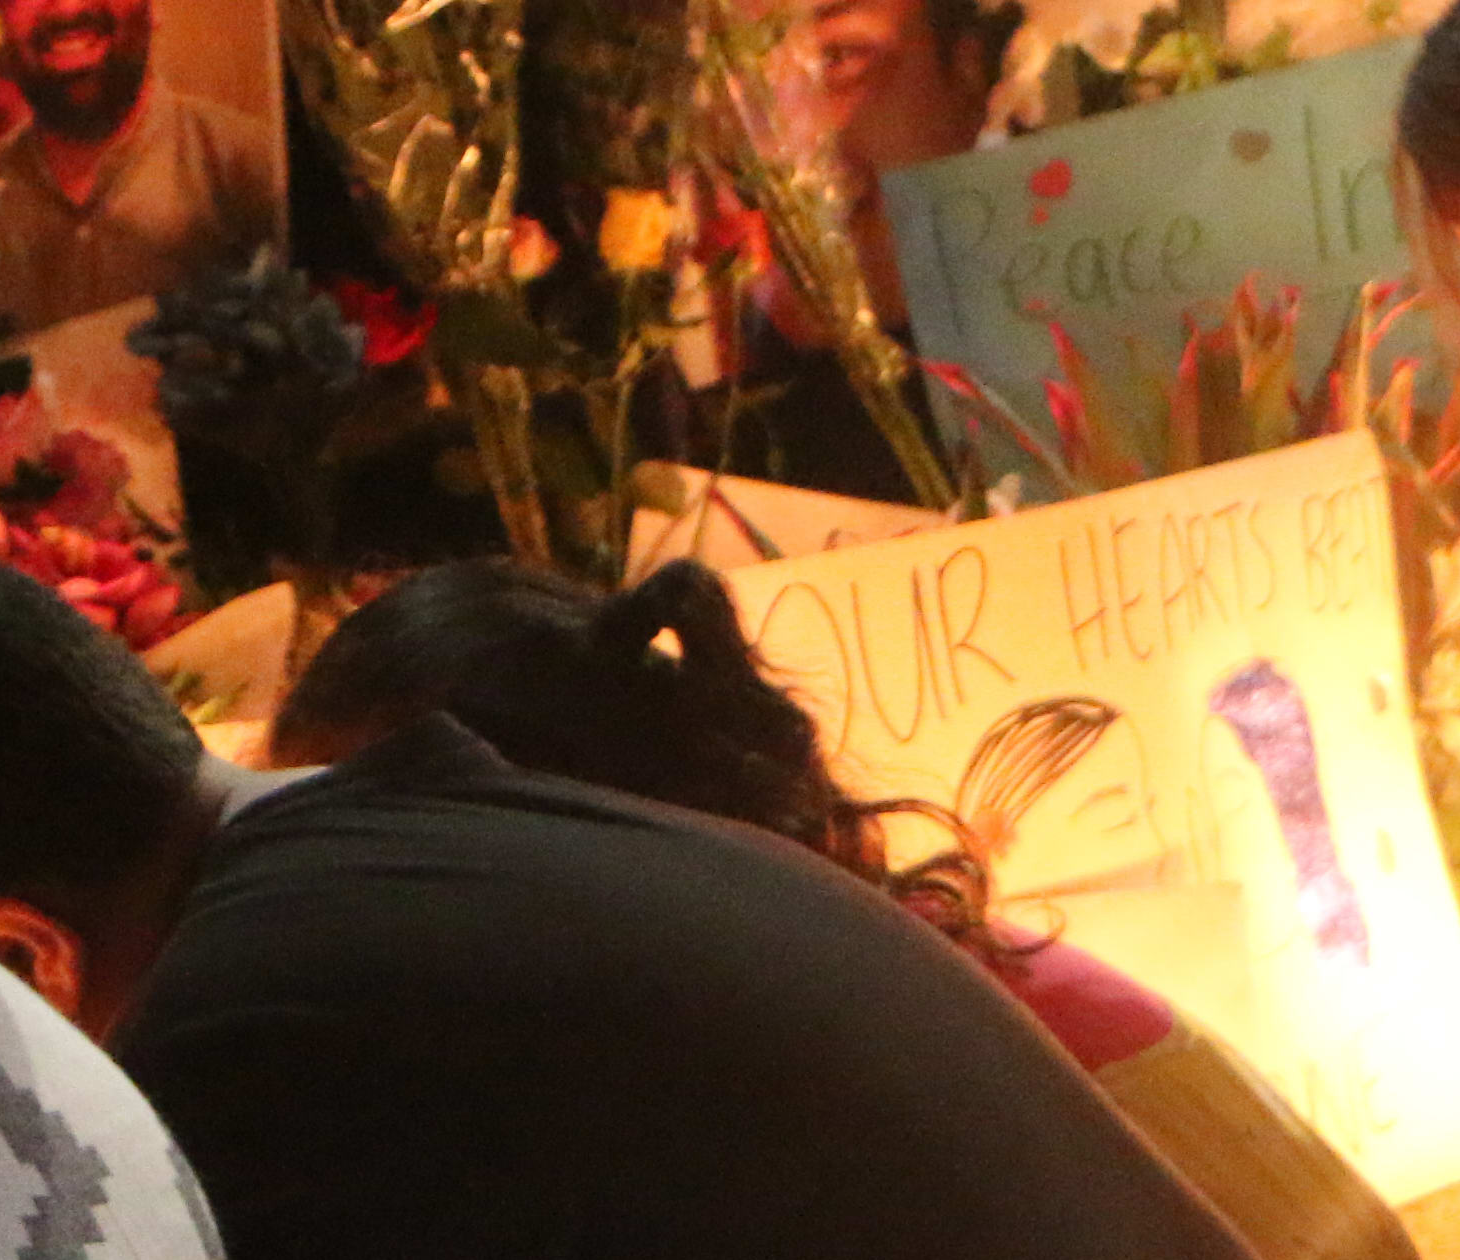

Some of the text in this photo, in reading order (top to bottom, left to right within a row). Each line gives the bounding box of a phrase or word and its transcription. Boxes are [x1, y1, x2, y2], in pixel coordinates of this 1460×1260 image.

[928, 103, 1406, 336] Peace In
[754, 544, 1018, 755] OUR
[1057, 499, 1278, 673] HEARTS
